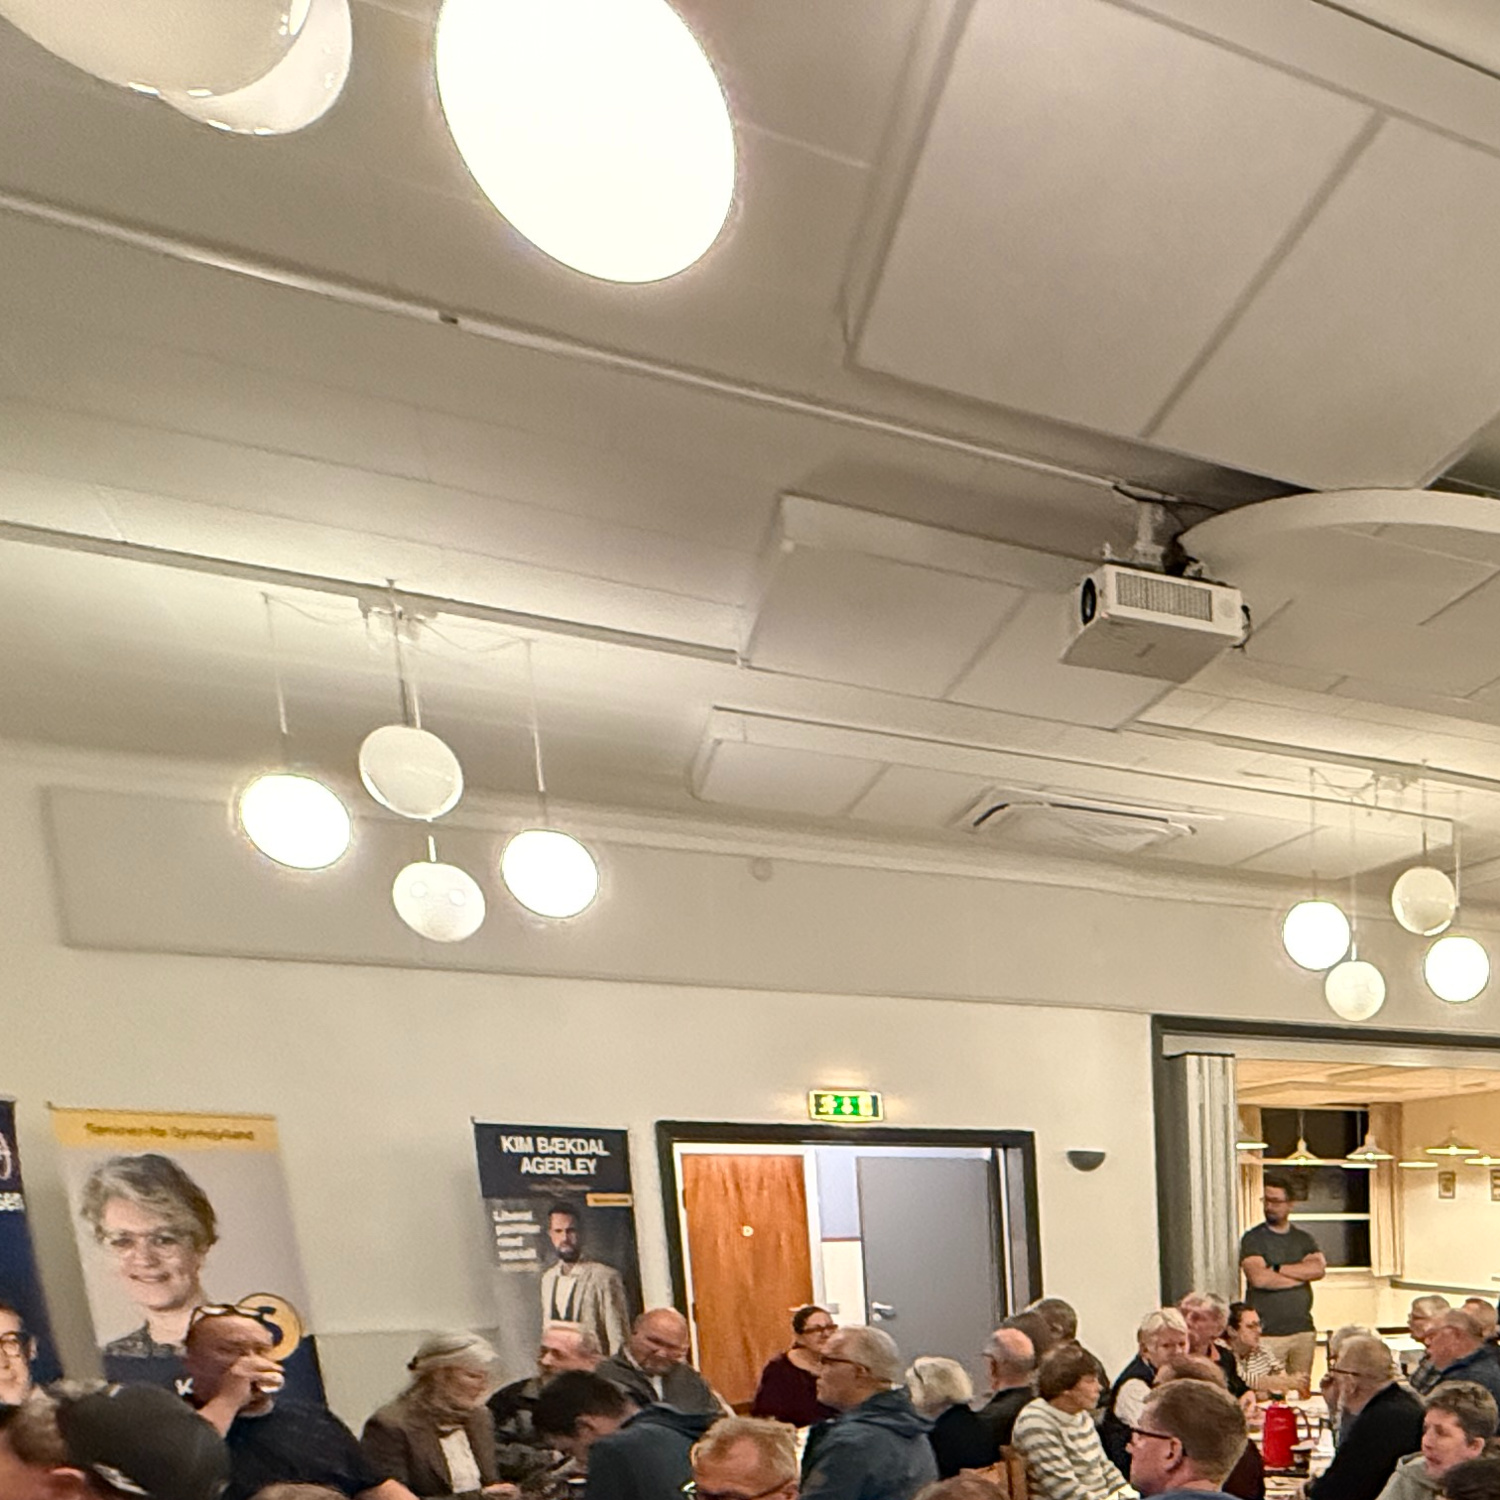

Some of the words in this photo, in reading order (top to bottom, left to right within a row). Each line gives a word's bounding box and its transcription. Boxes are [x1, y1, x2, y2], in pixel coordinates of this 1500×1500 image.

[500, 1135, 534, 1153] KIM
[536, 1137, 611, 1156] BÆKDAL
[520, 1156, 598, 1175] AGERLEY
